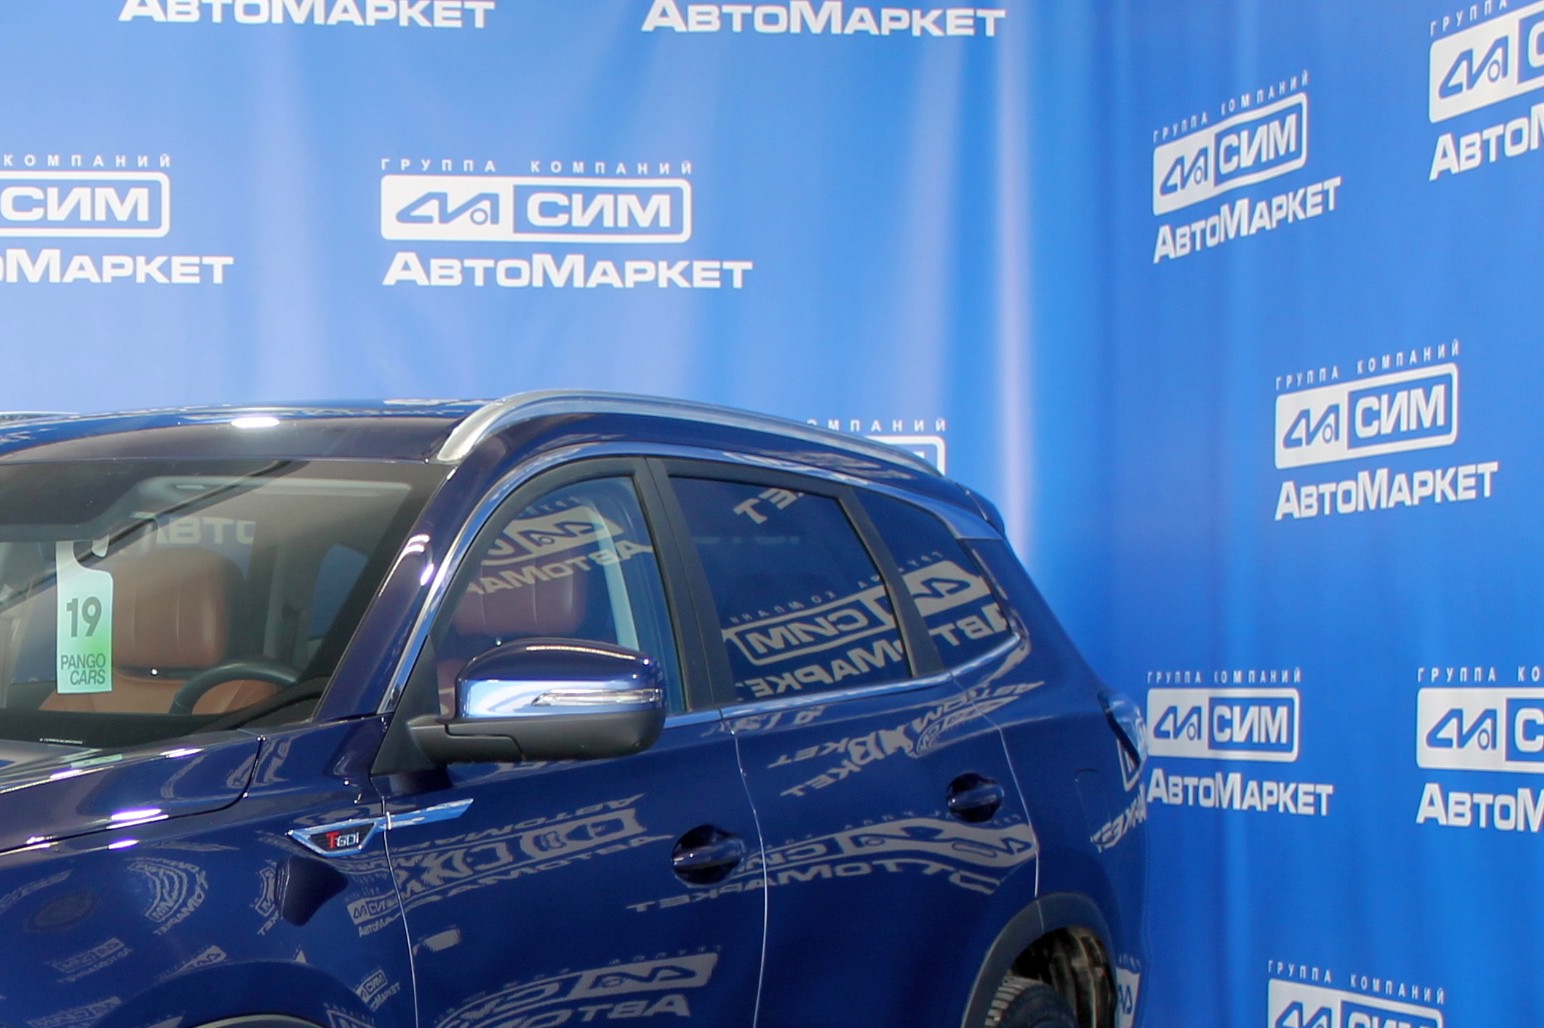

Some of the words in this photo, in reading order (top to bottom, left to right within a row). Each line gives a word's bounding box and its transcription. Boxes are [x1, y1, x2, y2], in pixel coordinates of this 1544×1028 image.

[1153, 111, 1208, 142] ГРУППА
[1221, 70, 1310, 115] КОМПАНИЙ
[4, 154, 170, 167] КОМПАНИЙ
[1218, 115, 1296, 174] СИМ
[381, 158, 497, 172] ГРУППА
[531, 161, 692, 174] КОМПАНИЙ
[1, 187, 148, 221] СИМ
[528, 193, 670, 227] СИМ
[1276, 365, 1340, 389] ГРУППА
[1357, 339, 1460, 374] КОМПАНИЙ
[807, 418, 946, 433] МПАНИЙ
[1355, 384, 1445, 436] СИМ
[66, 596, 102, 638] 19
[61, 653, 106, 670] PANGO
[69, 669, 106, 686] CARS
[1147, 670, 1202, 684] ГРУППА
[1417, 667, 1496, 683] ГРУППА
[1213, 705, 1288, 744] СИМ
[1268, 960, 1332, 985] ГРУППА
[1351, 973, 1445, 1005] КОМПАНИЙ
